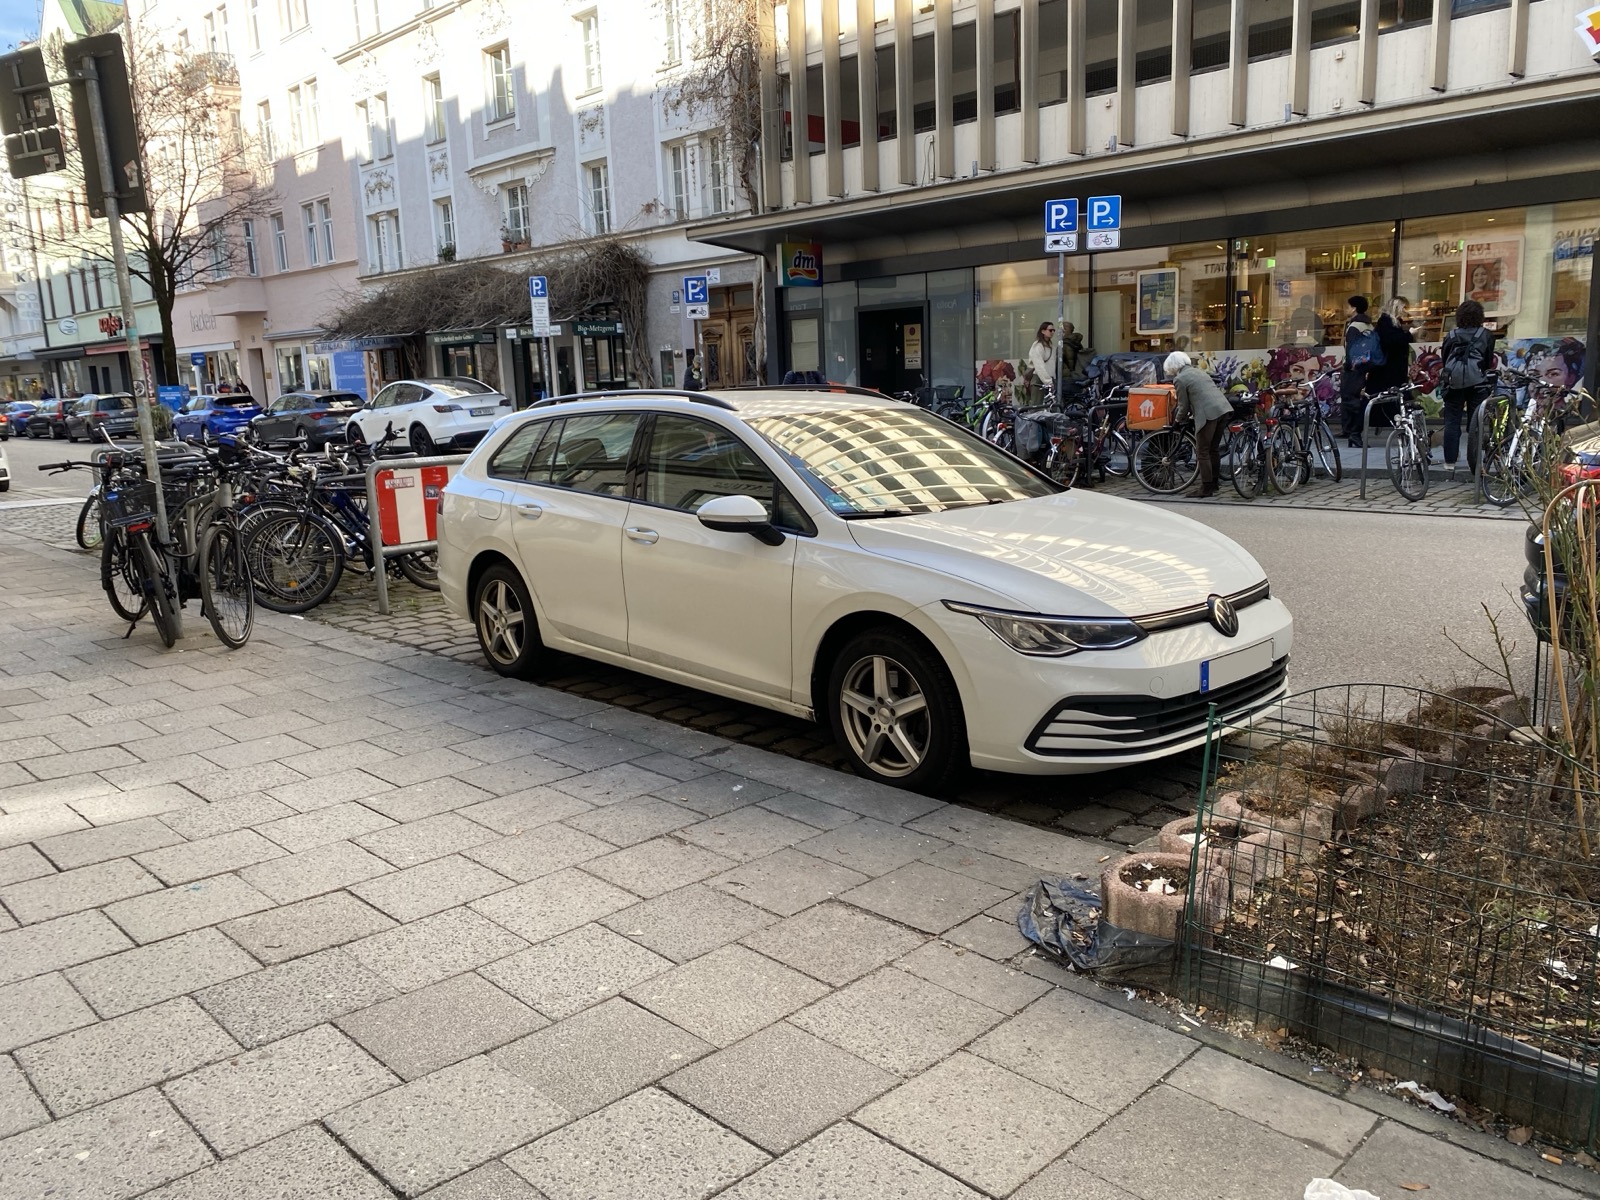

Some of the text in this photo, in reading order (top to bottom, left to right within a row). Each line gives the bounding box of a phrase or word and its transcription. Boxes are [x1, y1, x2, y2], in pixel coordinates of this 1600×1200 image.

[1051, 204, 1068, 229] P
[1093, 201, 1111, 226] P
[793, 250, 815, 269] dm
[532, 279, 542, 295] P
[687, 280, 701, 301] P
[577, 324, 615, 334] Bio-Metzgerei
